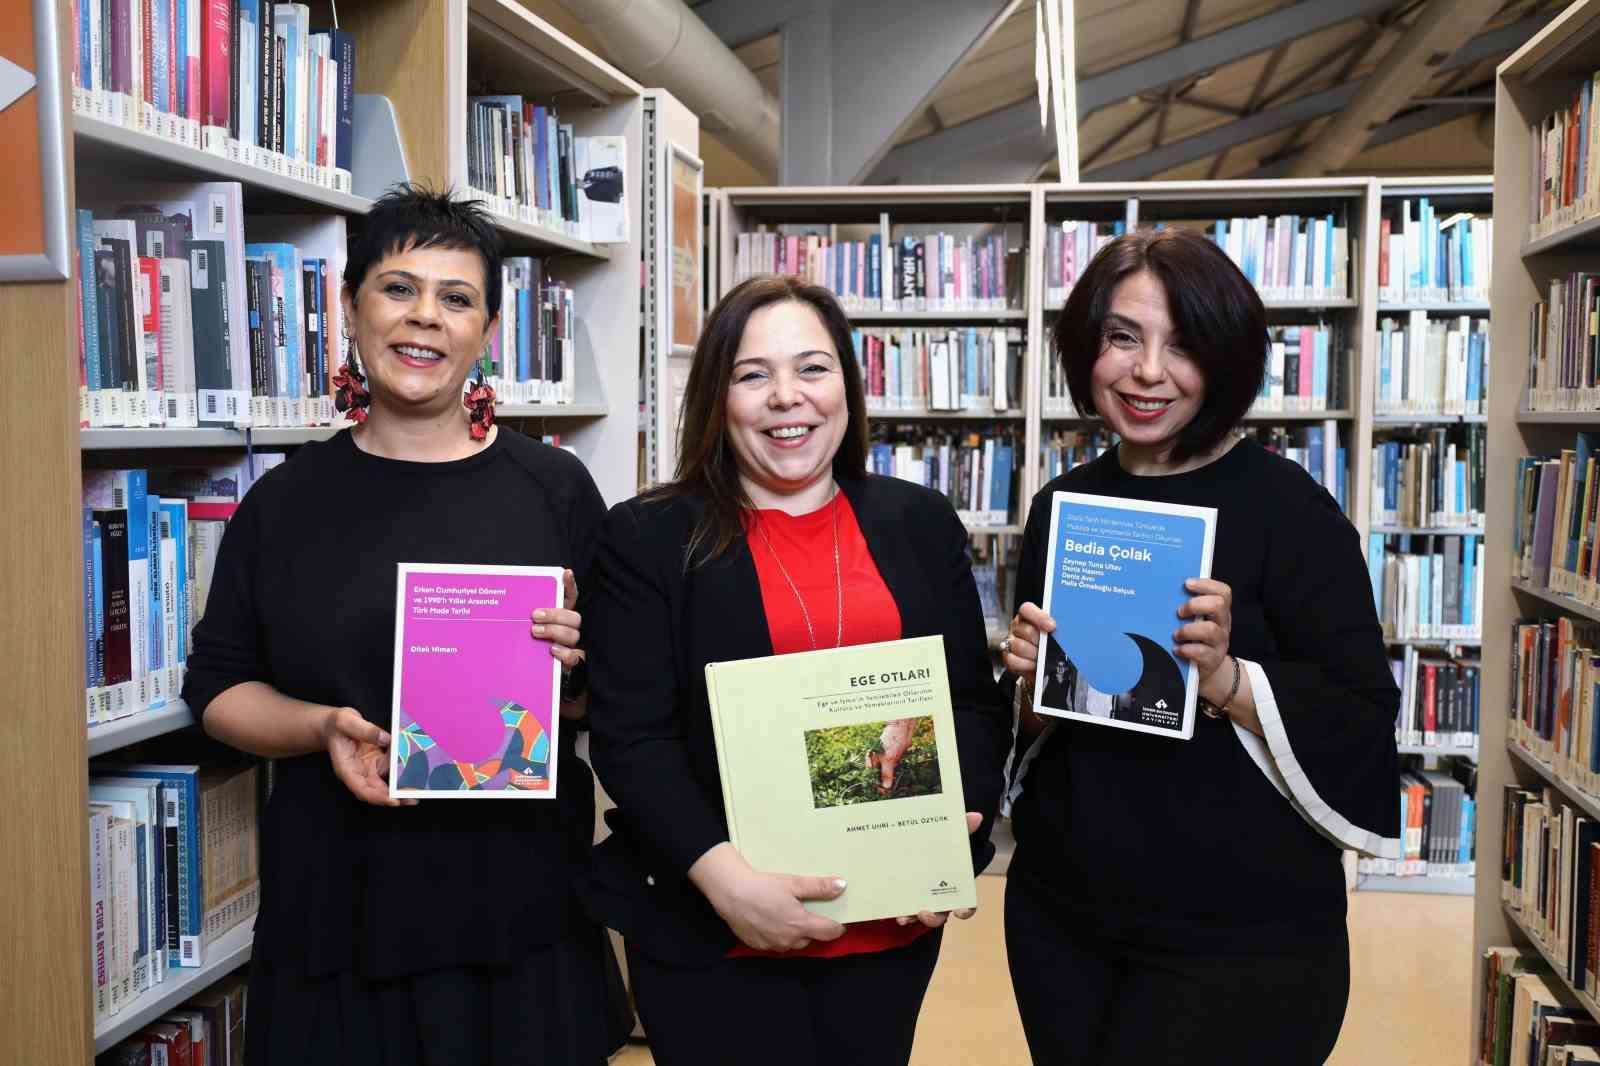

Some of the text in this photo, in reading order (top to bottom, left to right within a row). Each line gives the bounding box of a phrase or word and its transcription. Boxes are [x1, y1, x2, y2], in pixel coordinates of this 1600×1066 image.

[903, 257, 916, 299] HRANT
[1064, 538, 1153, 562] Bedia Çolak
[1063, 557, 1087, 567] Zeynep
[1062, 564, 1080, 572] Deniz
[1062, 571, 1080, 580] Deniz
[413, 586, 506, 596] Erken Cumhuriyet Dönemi
[468, 598, 500, 606] Arasında
[413, 606, 471, 615] Türk Moda Tarihi
[410, 645, 458, 654] Dilek Himam
[850, 667, 931, 688] EGE OTLARI
[817, 701, 829, 710] Ege
[846, 824, 870, 833] AHMET
